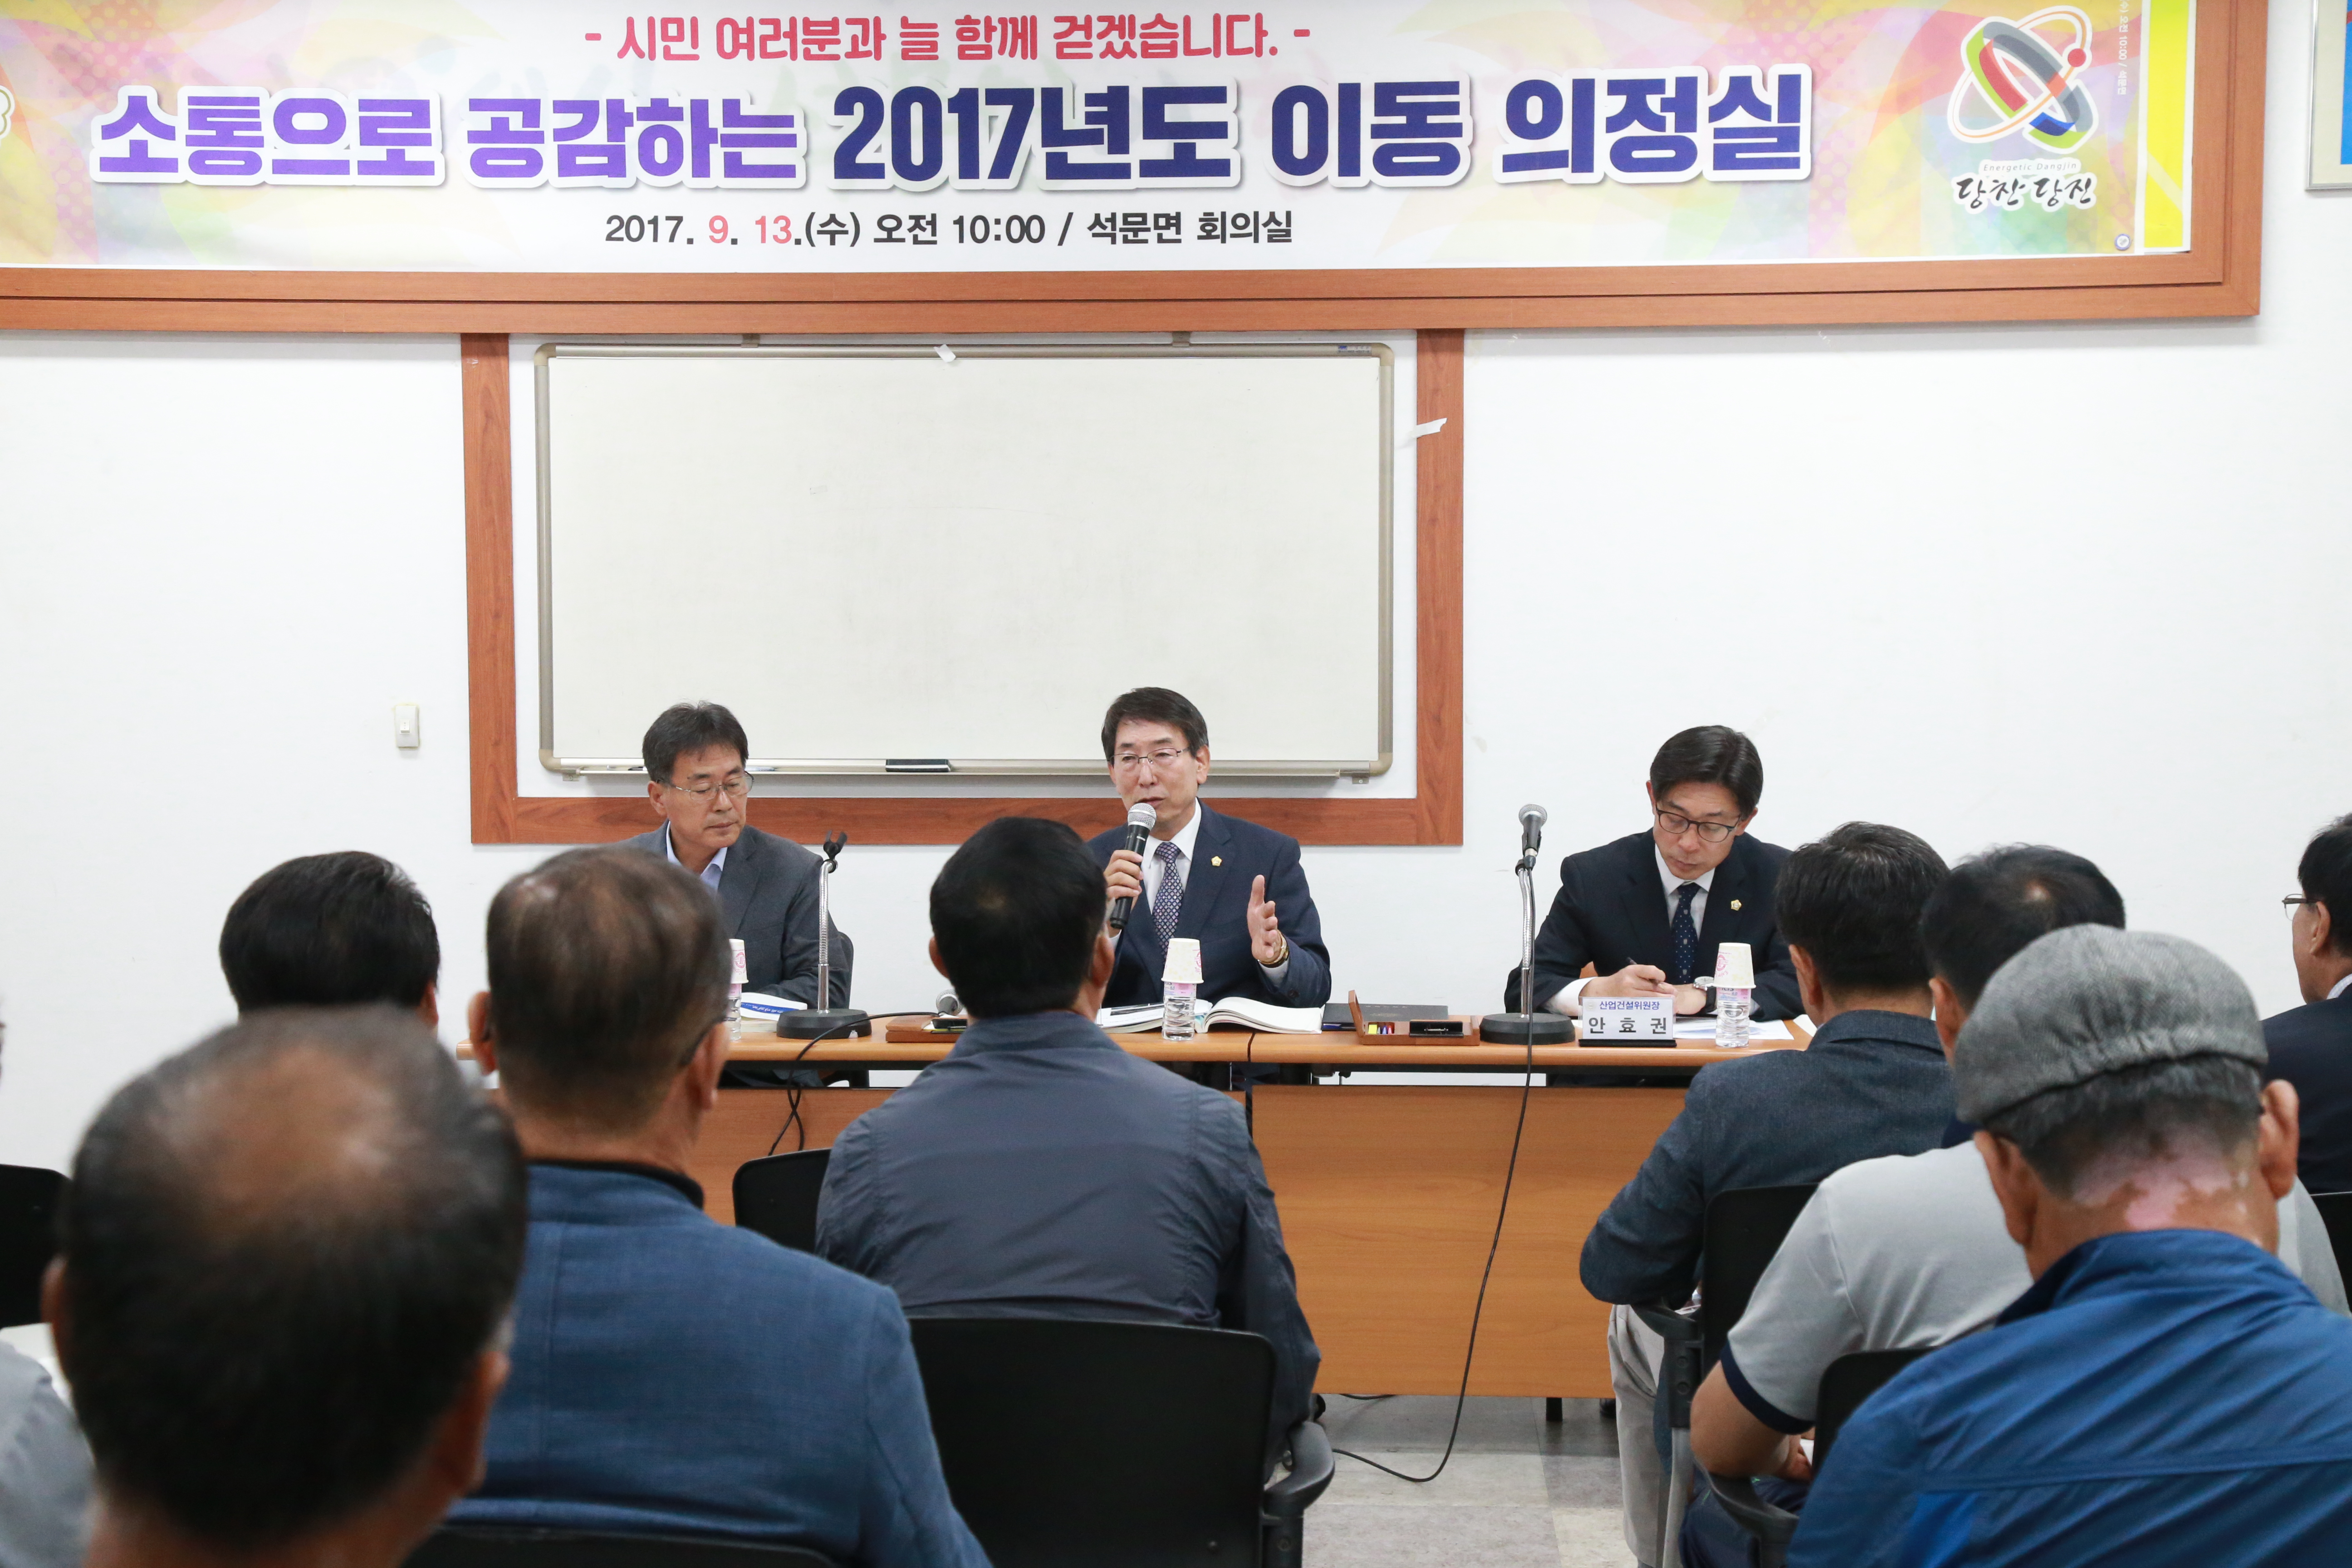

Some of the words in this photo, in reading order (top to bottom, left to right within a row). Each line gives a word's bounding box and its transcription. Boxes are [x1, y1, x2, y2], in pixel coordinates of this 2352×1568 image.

[2119, 0, 2130, 13] 수)
[2119, 15, 2129, 33] 오전
[617, 16, 700, 61] 시민
[716, 16, 887, 61] 여러분과
[900, 16, 940, 60] 늘
[955, 15, 1038, 60] 함께
[1054, 13, 1278, 59] 걷겠습니다.
[2118, 35, 2128, 60] 10:00
[2117, 70, 2127, 95] 석문면
[99, 95, 441, 176] 소통으로
[467, 98, 797, 179] 공감하는
[833, 85, 1231, 182] 2017년도
[1271, 81, 1464, 177] 이동
[1501, 74, 1802, 174] 의정실
[1983, 164, 2032, 172] Energetic
[2036, 162, 2077, 171] Dangjin
[1956, 178, 2026, 209] 당찬
[2033, 178, 2092, 207] 당진
[605, 215, 694, 245] 2017.
[709, 215, 738, 245] 9.
[755, 212, 861, 247] 13.(수)
[873, 213, 938, 245] 오전
[953, 215, 1046, 244] 10:00
[1057, 212, 1074, 246] /
[1087, 211, 1182, 245] 석문면
[1197, 211, 1293, 244] 회의실
[1599, 1001, 1660, 1010] 산업건설위원장
[1588, 1017, 1606, 1034] 안
[1619, 1017, 1637, 1033] 효
[1650, 1017, 1666, 1034] 권
